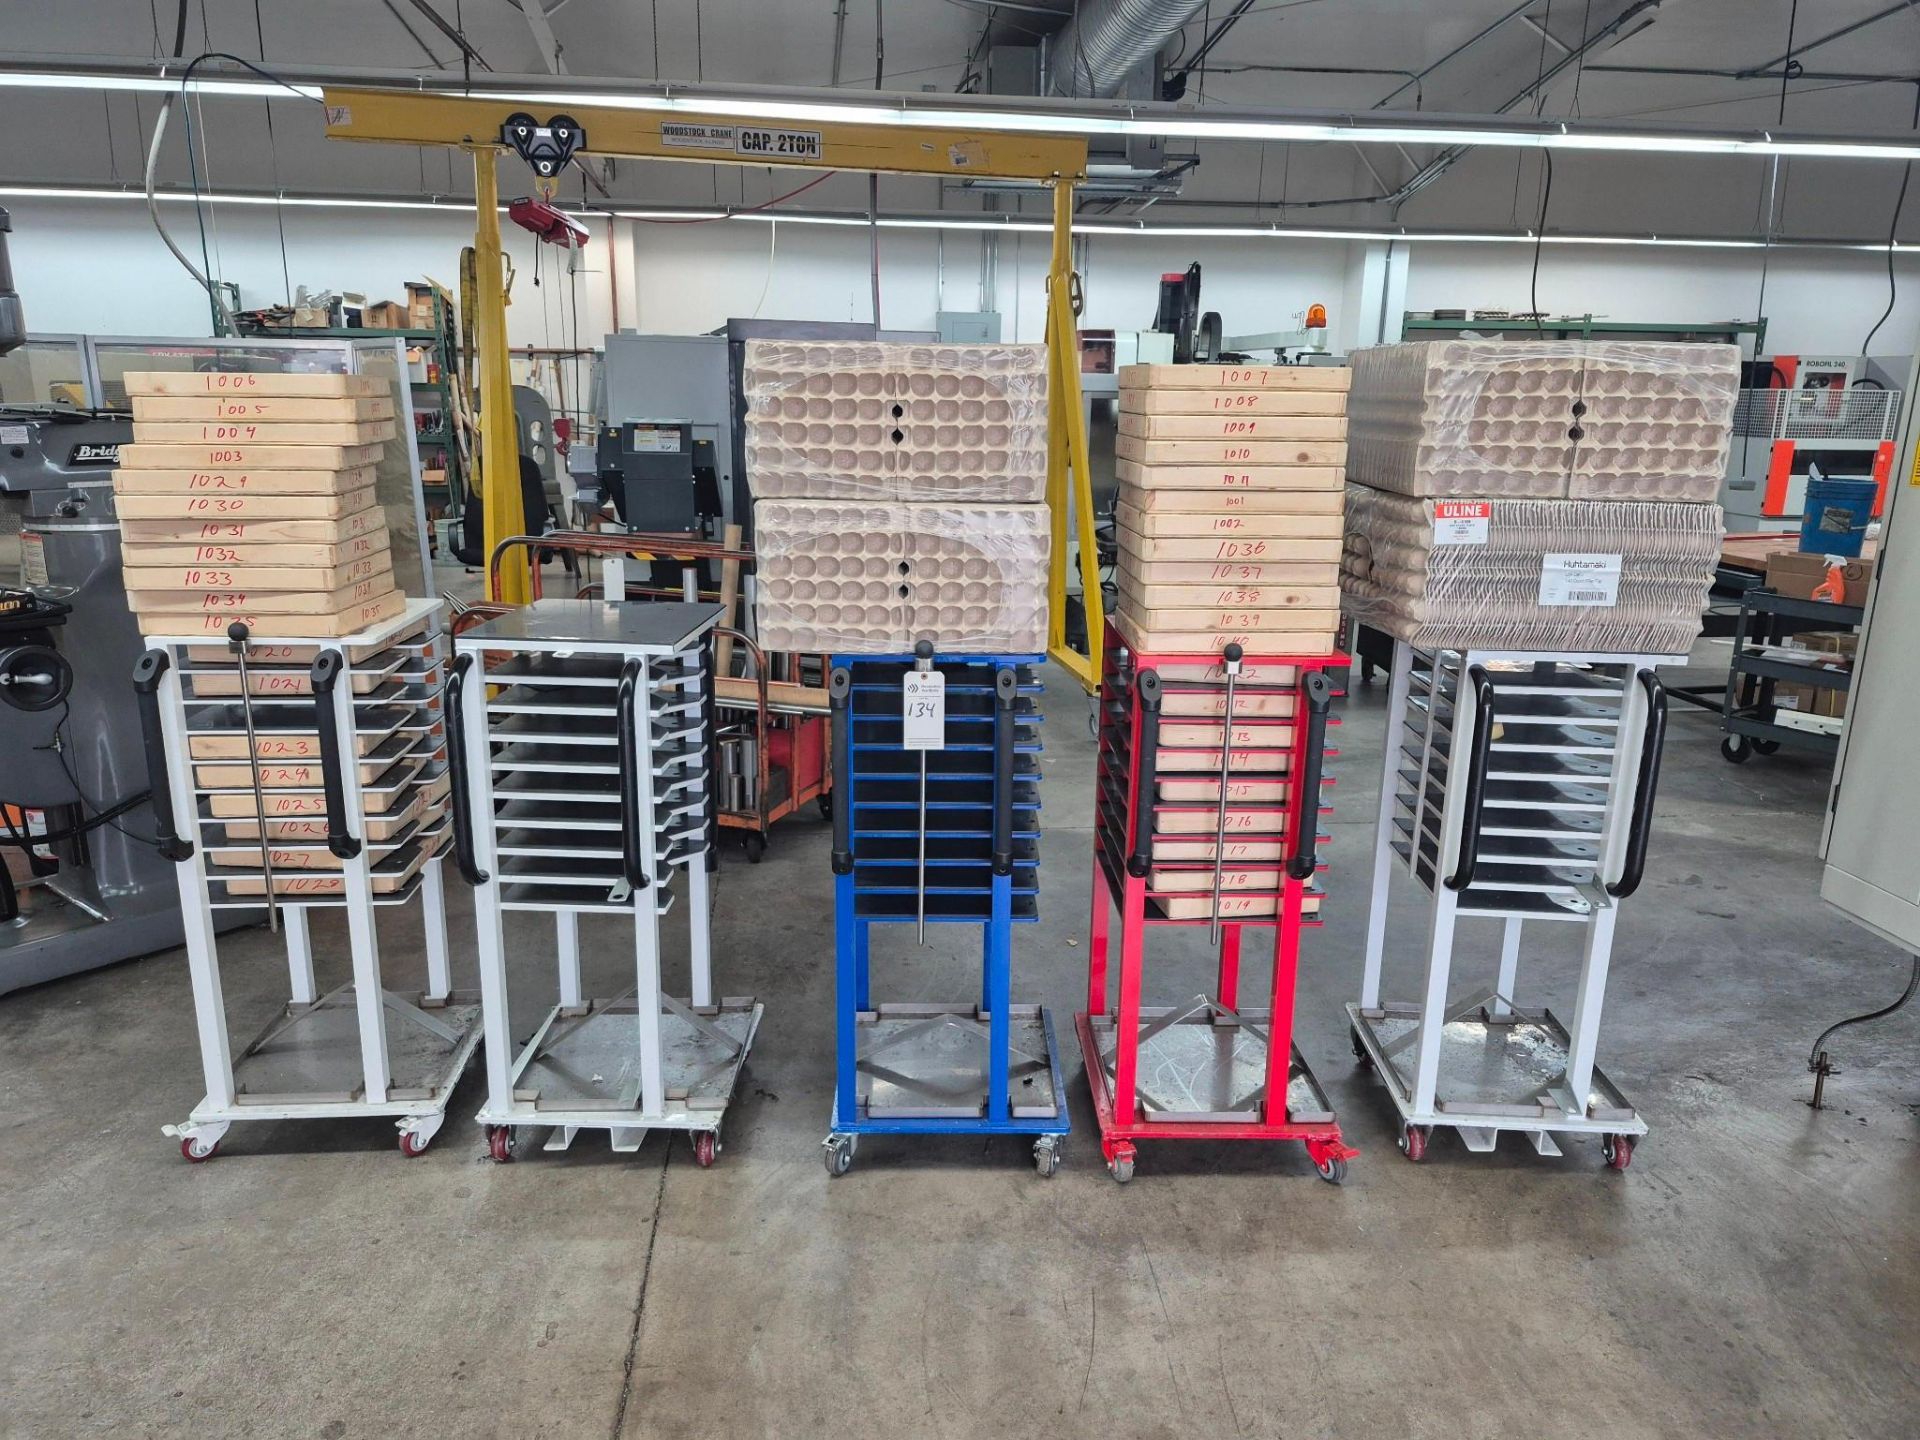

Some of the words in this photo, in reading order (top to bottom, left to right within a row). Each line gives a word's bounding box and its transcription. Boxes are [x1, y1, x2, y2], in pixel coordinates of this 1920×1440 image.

[663, 126, 706, 138] WOODSTOCK
[711, 128, 733, 138] CRANE
[741, 131, 773, 151] CAP.
[778, 134, 816, 154] 2TON
[1806, 360, 1832, 368] ROBOFIL
[206, 375, 256, 391] 1006
[1221, 370, 1269, 385] 1007
[1214, 395, 1259, 409] 1008
[218, 403, 270, 416] 1005
[203, 426, 257, 439] 1004
[1224, 421, 1256, 434] 1009
[210, 450, 243, 464] 1003
[1224, 448, 1251, 460] 1010
[189, 473, 248, 489] 1029
[188, 499, 244, 512] 1030
[1444, 505, 1483, 517] ULINE
[200, 523, 244, 538] 1031
[1213, 519, 1245, 530] 1002
[196, 547, 244, 562] 1032
[1216, 542, 1266, 559] 1036
[1563, 559, 1607, 569] Huhtamaki
[185, 570, 233, 586] 1033
[1211, 564, 1262, 580] 1037
[203, 593, 247, 607] 1034
[1217, 591, 1261, 605] 1038
[1220, 614, 1262, 627] 1039
[249, 646, 293, 657] 020
[1204, 665, 1261, 680] 102
[908, 702, 937, 718] 134
[1219, 731, 1250, 742] 113
[1213, 752, 1249, 767] 114
[260, 768, 310, 782] 024
[276, 799, 327, 812] 1025
[1208, 845, 1248, 857] 117
